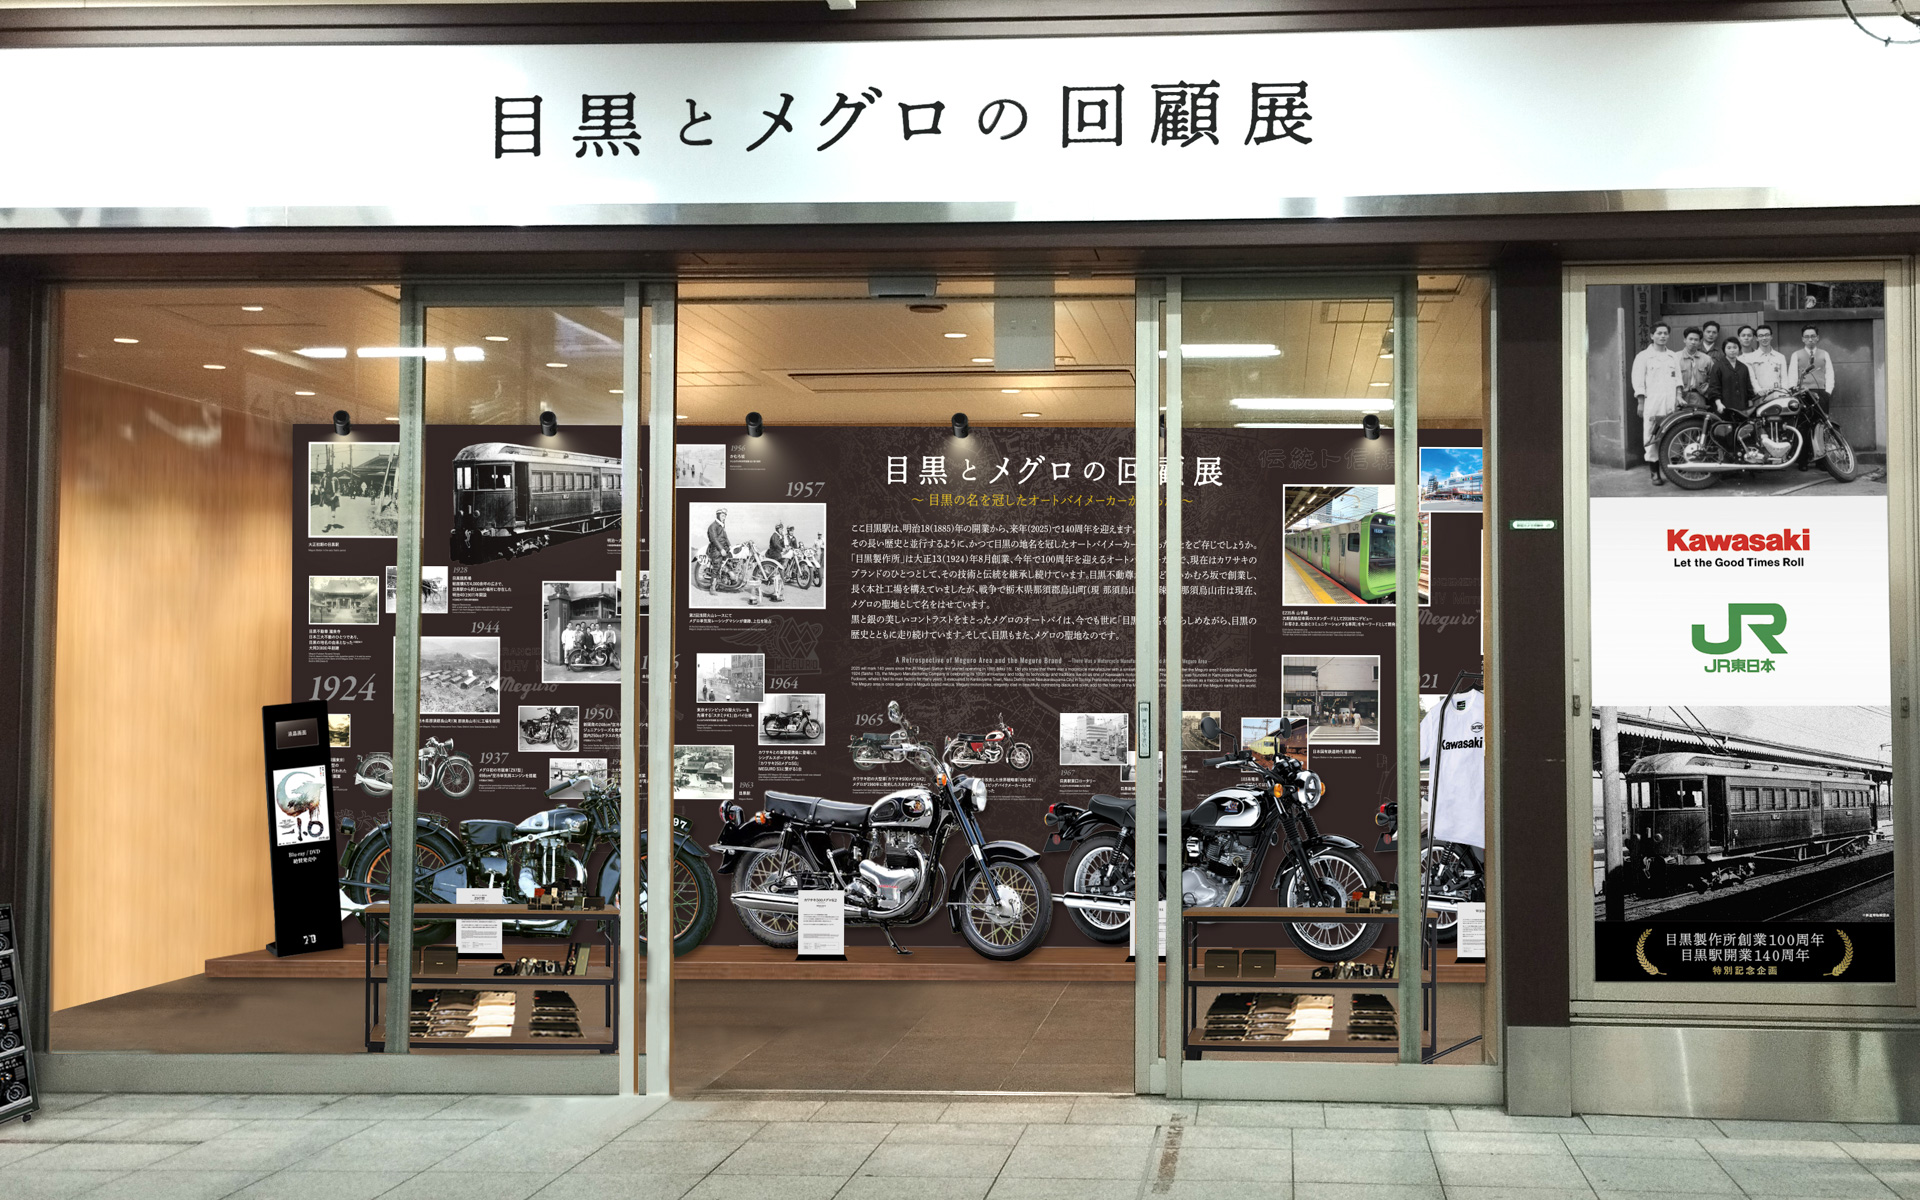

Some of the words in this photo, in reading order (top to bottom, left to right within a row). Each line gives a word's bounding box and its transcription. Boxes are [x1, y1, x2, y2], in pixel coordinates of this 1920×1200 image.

[494, 82, 1313, 159] 目黒とメグロの回顧展
[786, 482, 825, 498] 1957
[1667, 528, 1810, 552] Kawasaki
[1674, 558, 1691, 567] Let
[1694, 558, 1712, 567] the
[1714, 558, 1744, 567] Good
[1746, 558, 1780, 567] Times
[1782, 558, 1804, 567] Roll
[851, 600, 990, 610] メグロの聖地として名をはせています。
[471, 621, 500, 634] 1944
[1692, 603, 1788, 655] JR
[902, 656, 944, 664] Retrospective
[954, 657, 976, 665] Meguro
[1704, 658, 1776, 673] JR東日本
[310, 673, 376, 701] 1924
[770, 677, 798, 690] 1964
[584, 708, 613, 720] 1950
[855, 713, 884, 726] 1965
[480, 752, 509, 764] 1937
[1666, 932, 1824, 947] 目黒製作所創業100周年
[1682, 948, 1810, 962] 目黒駅開業140周年
[1712, 966, 1778, 976] 特別記念企画
